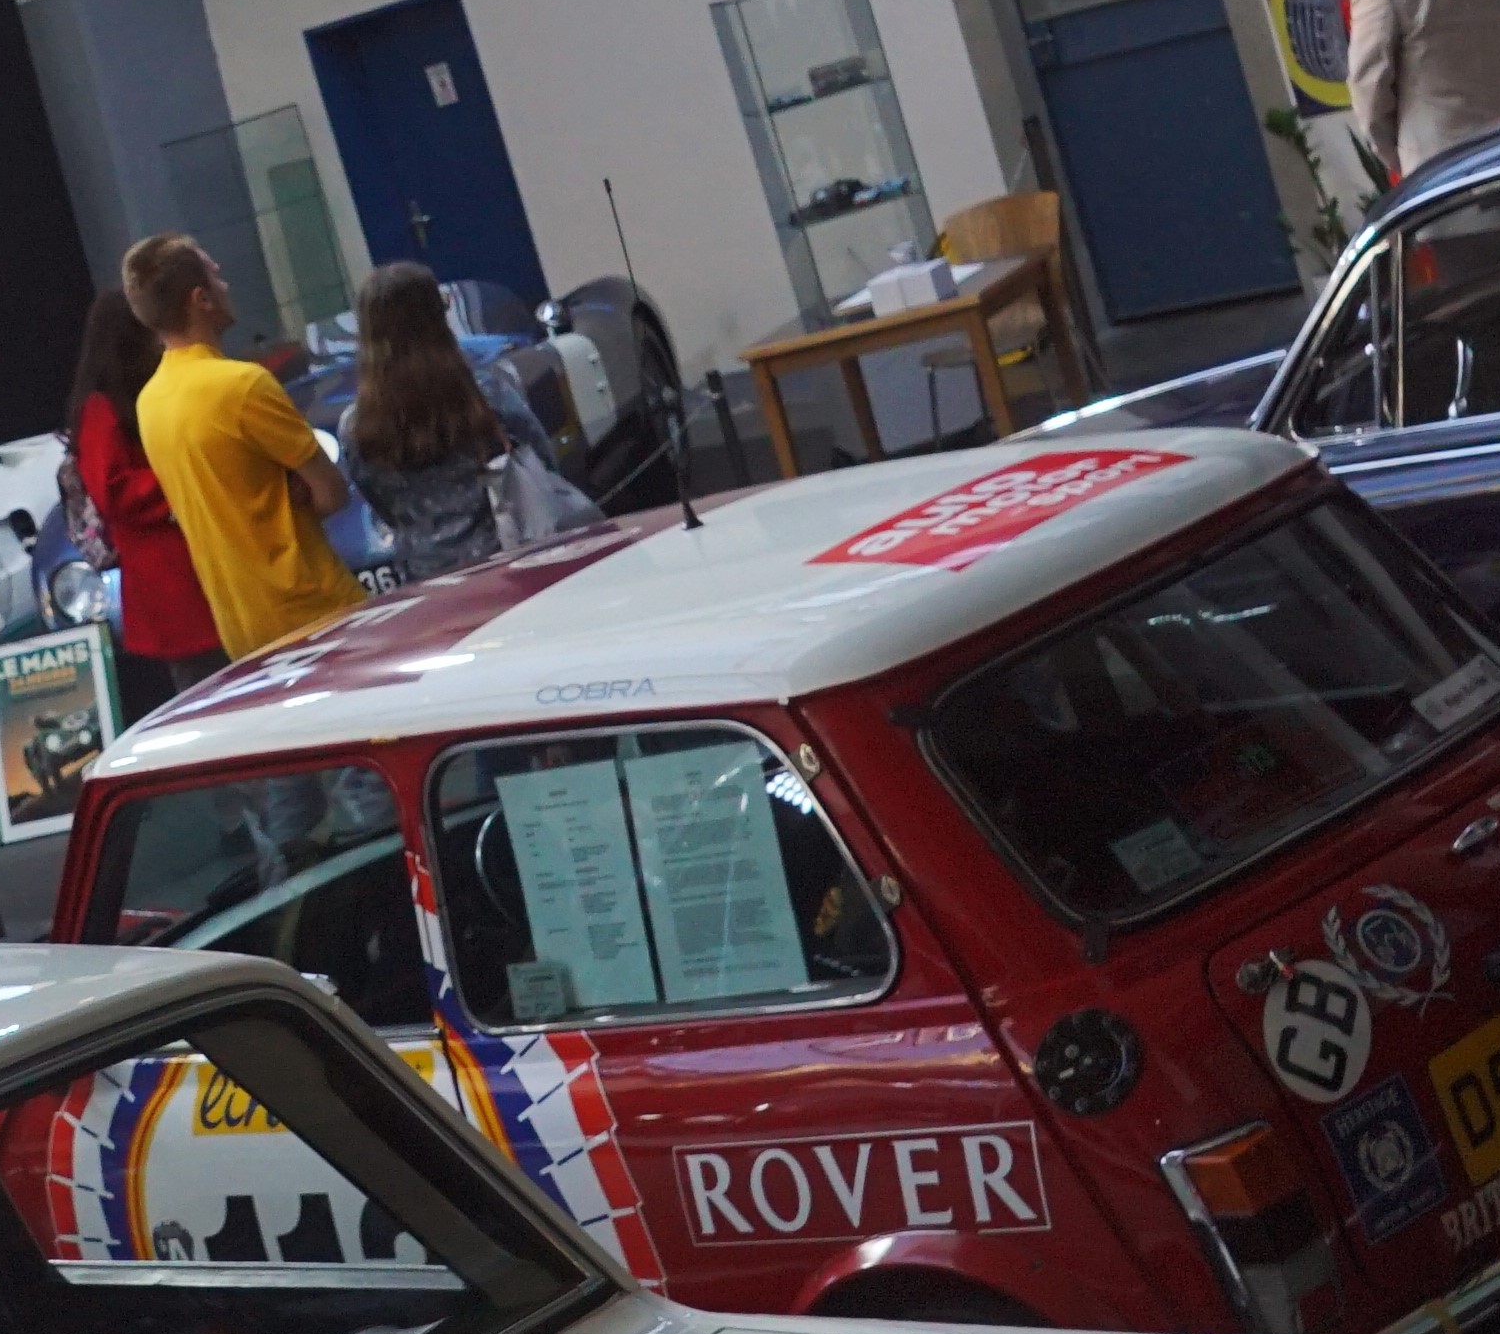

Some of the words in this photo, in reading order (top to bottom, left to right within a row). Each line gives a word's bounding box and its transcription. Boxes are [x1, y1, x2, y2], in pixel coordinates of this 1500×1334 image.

[846, 470, 1027, 556] auto
[926, 456, 1099, 535] motor
[1026, 453, 1162, 507] sport
[21, 642, 89, 675] MANS
[535, 676, 657, 706] COBRA
[1277, 972, 1358, 1093] GB
[684, 1133, 1038, 1236] ROVER
